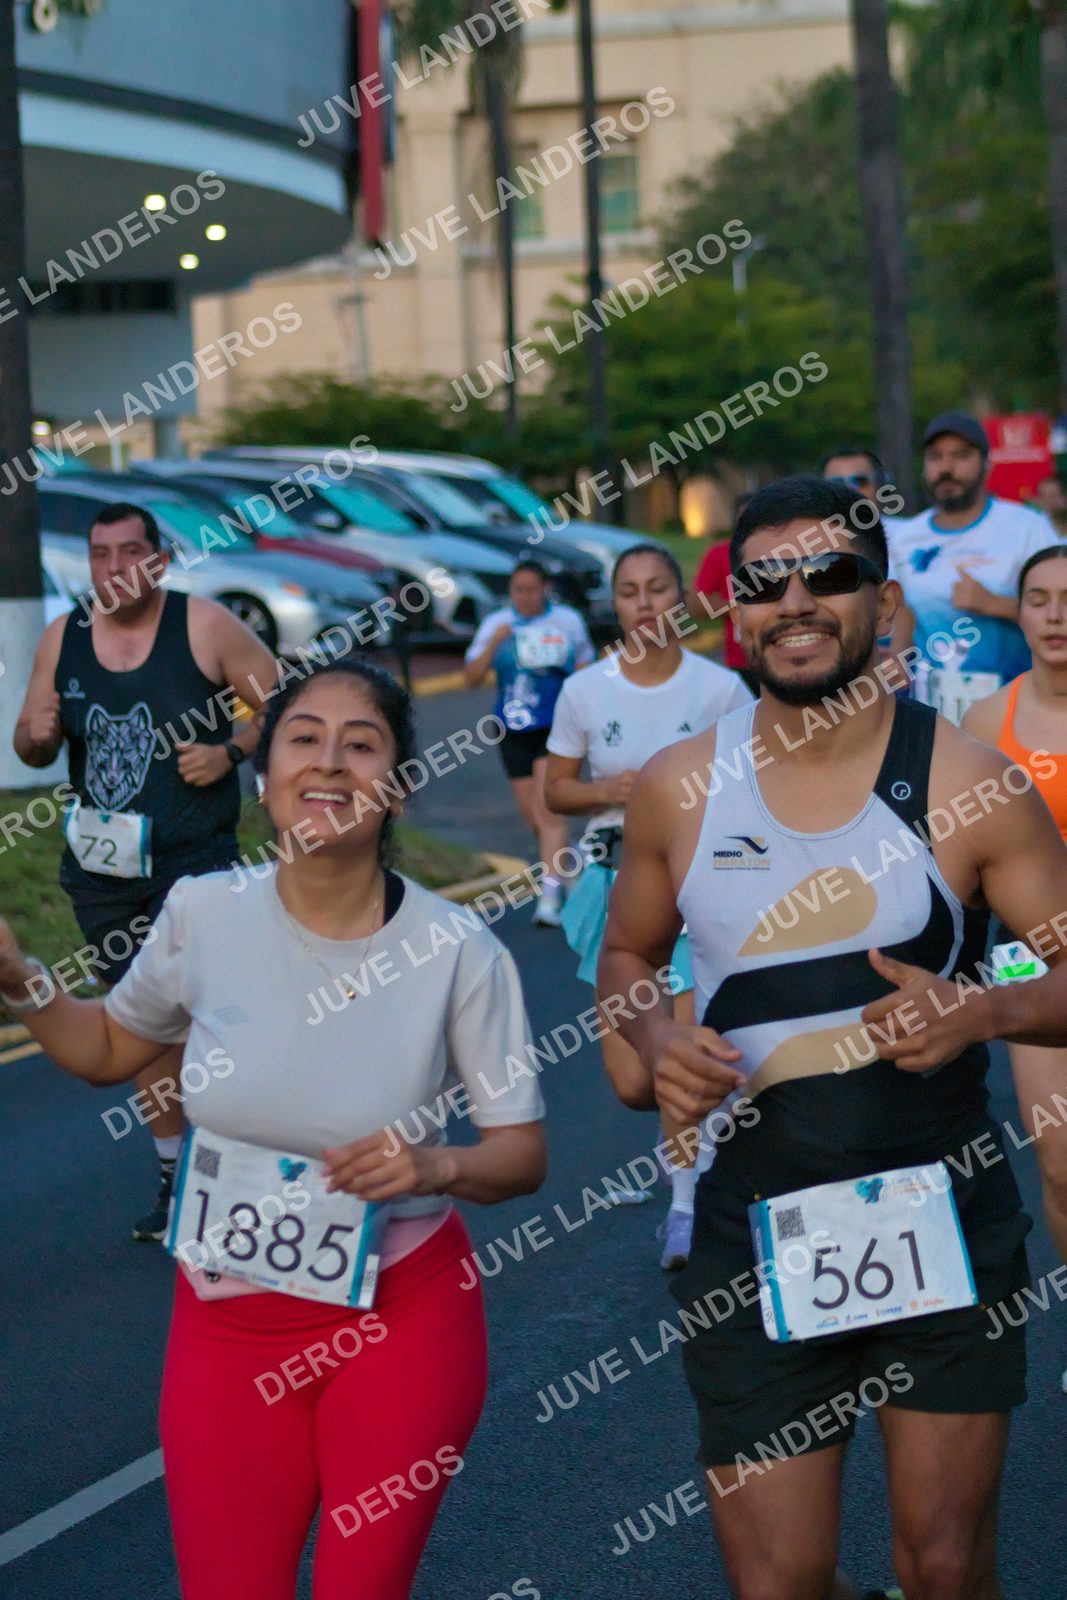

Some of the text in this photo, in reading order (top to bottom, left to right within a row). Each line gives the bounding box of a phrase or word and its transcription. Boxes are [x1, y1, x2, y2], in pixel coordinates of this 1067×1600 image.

[80, 834, 118, 867] 72
[713, 850, 743, 858] MEDIO
[196, 1189, 354, 1282] 1885
[812, 1230, 925, 1310] 561
